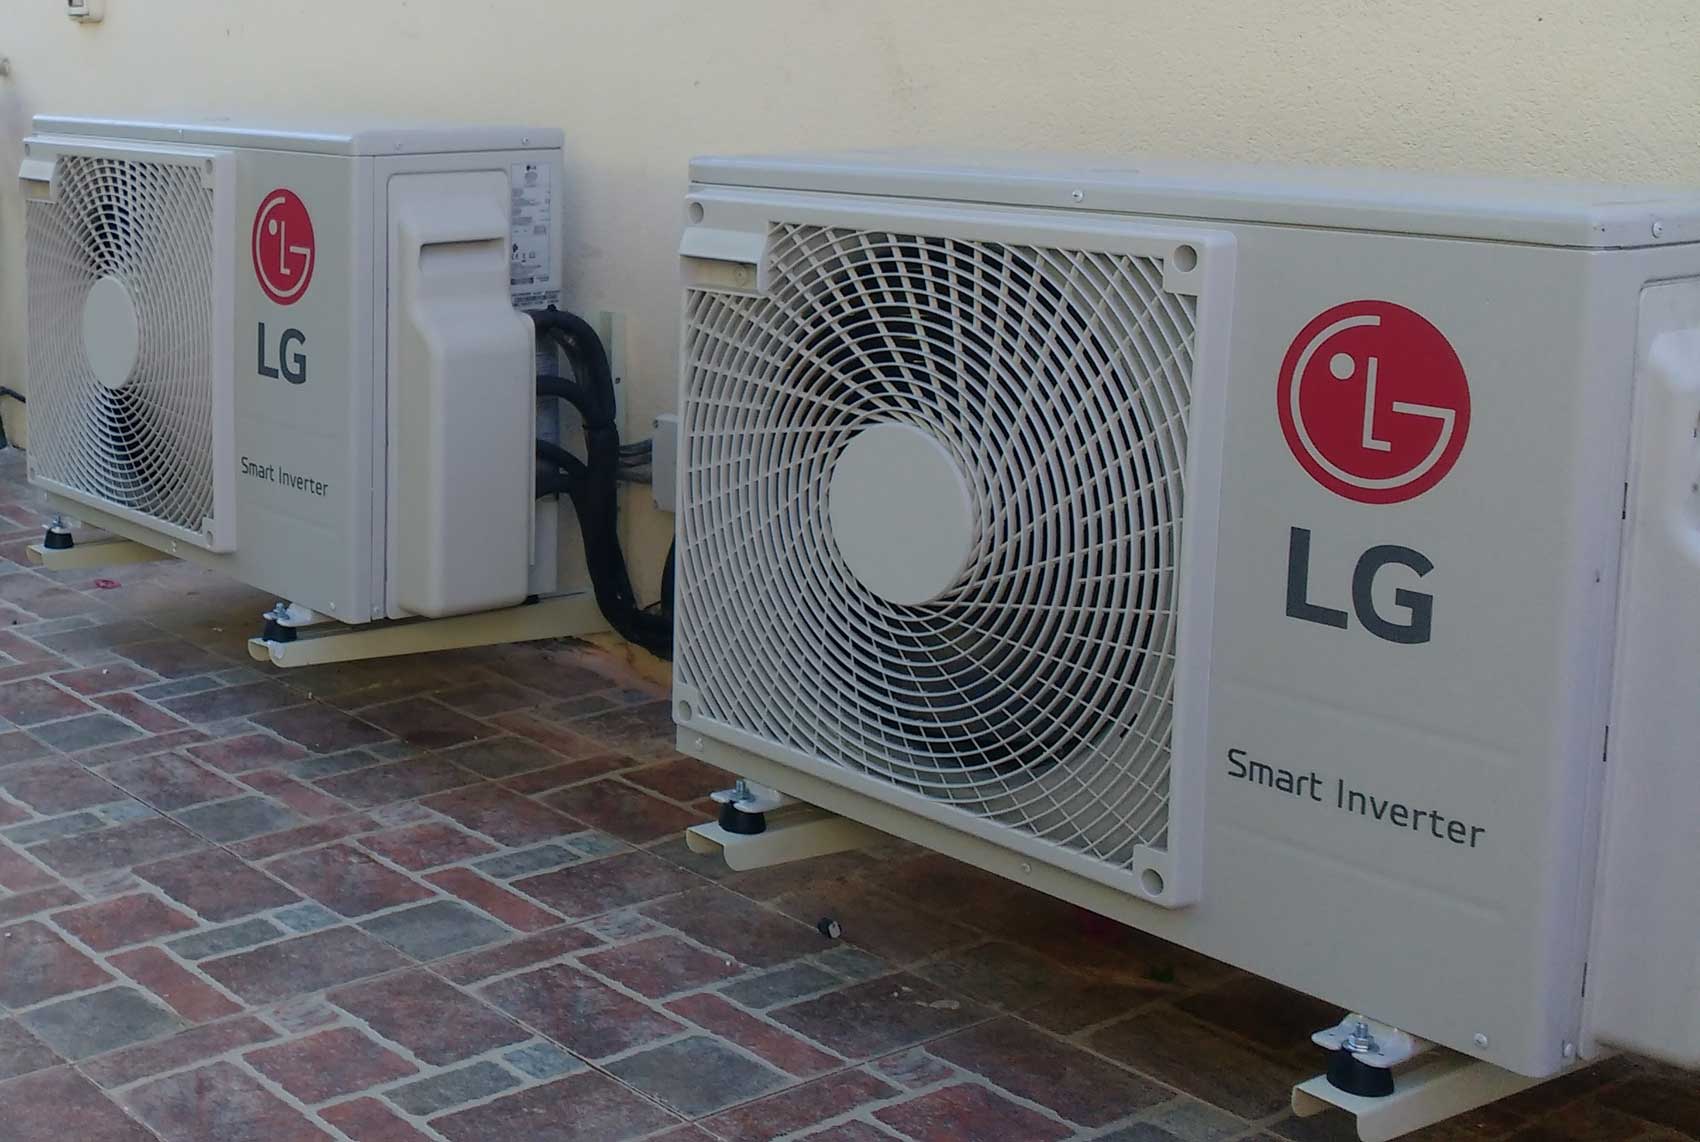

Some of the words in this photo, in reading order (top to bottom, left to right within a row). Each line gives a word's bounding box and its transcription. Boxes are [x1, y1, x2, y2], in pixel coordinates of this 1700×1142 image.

[257, 322, 306, 385] LG
[241, 456, 275, 482] Smart
[279, 466, 328, 497] Inverter
[1285, 526, 1434, 644] LG
[1227, 748, 1323, 802] Smart
[1337, 779, 1485, 848] Inverter
